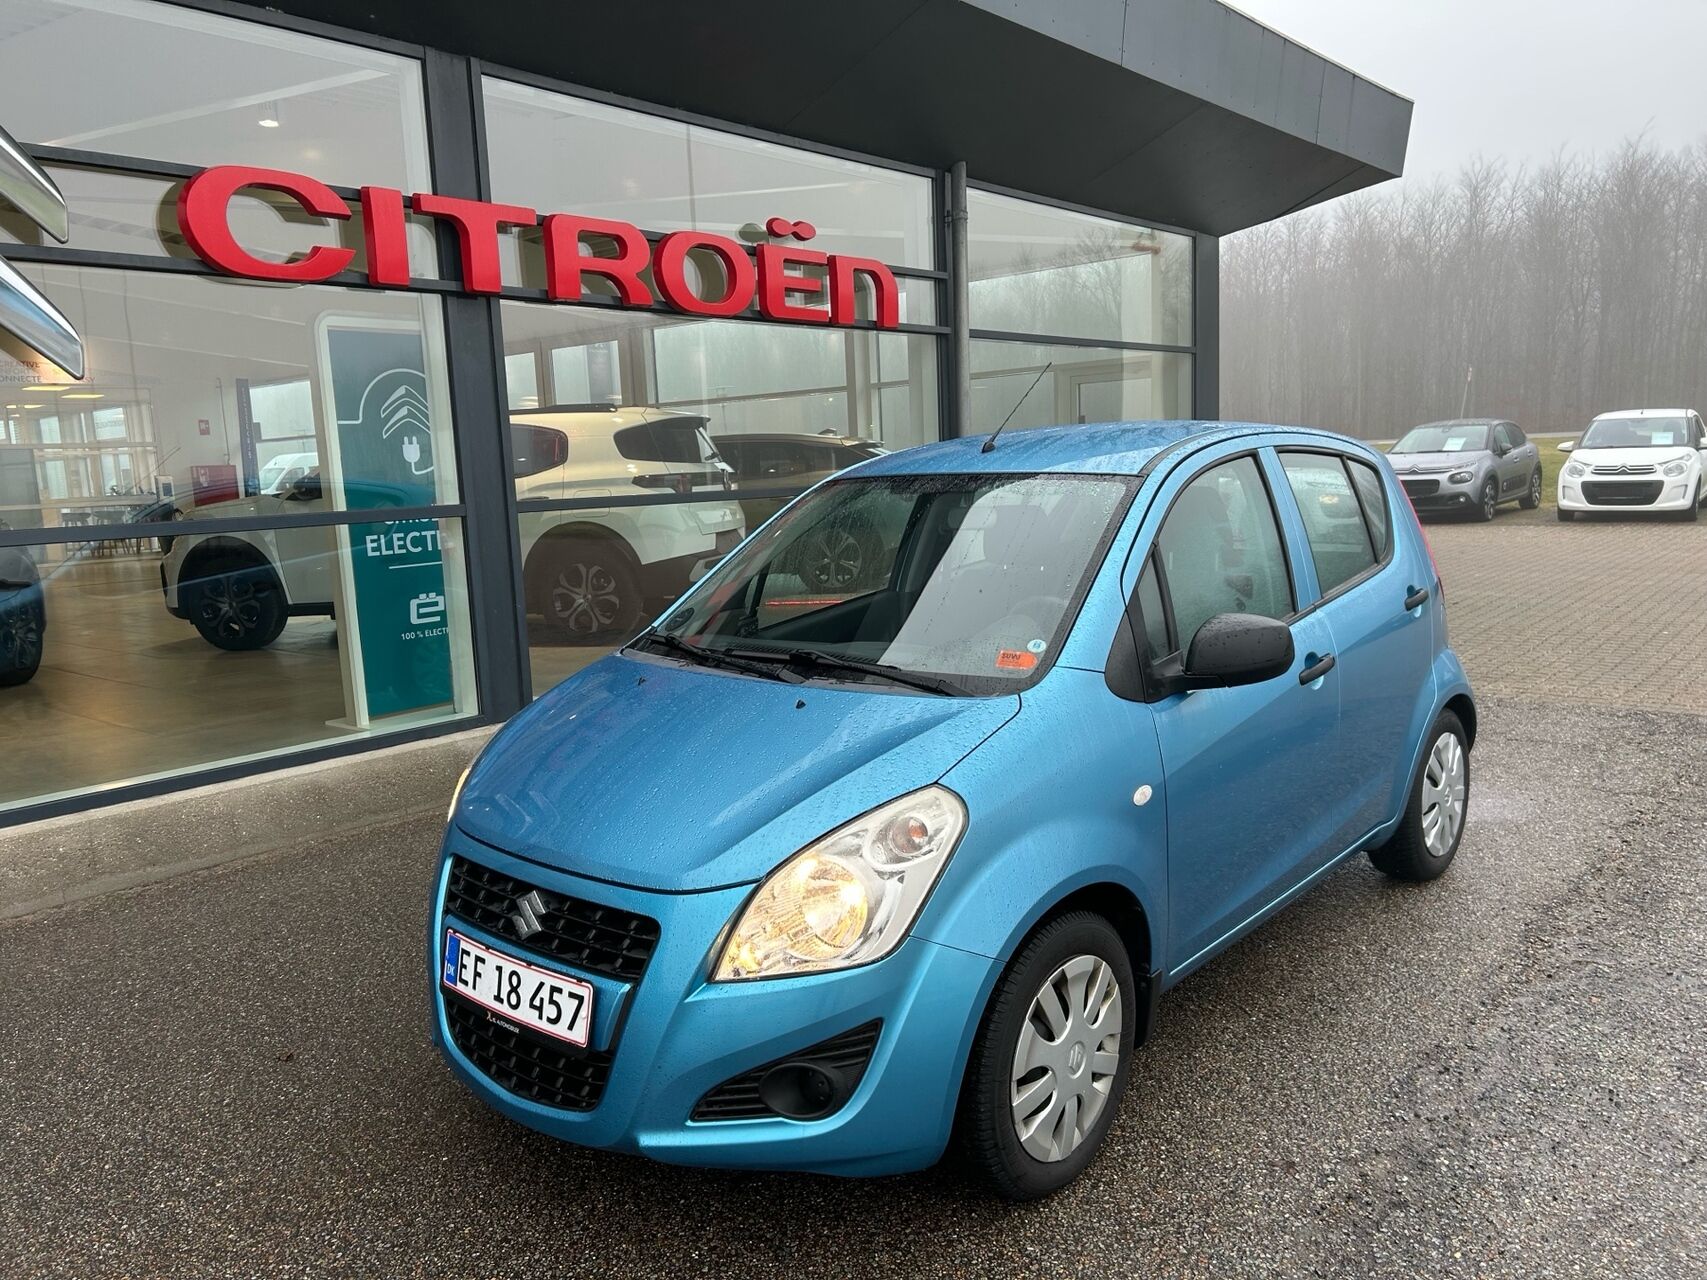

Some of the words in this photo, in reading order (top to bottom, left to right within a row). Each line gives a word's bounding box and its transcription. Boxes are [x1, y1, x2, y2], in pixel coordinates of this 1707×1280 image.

[401, 631, 416, 640] 100
[447, 963, 455, 976] DK
[459, 947, 486, 991] EF
[493, 965, 521, 1010] 18
[529, 981, 585, 1031] 457
